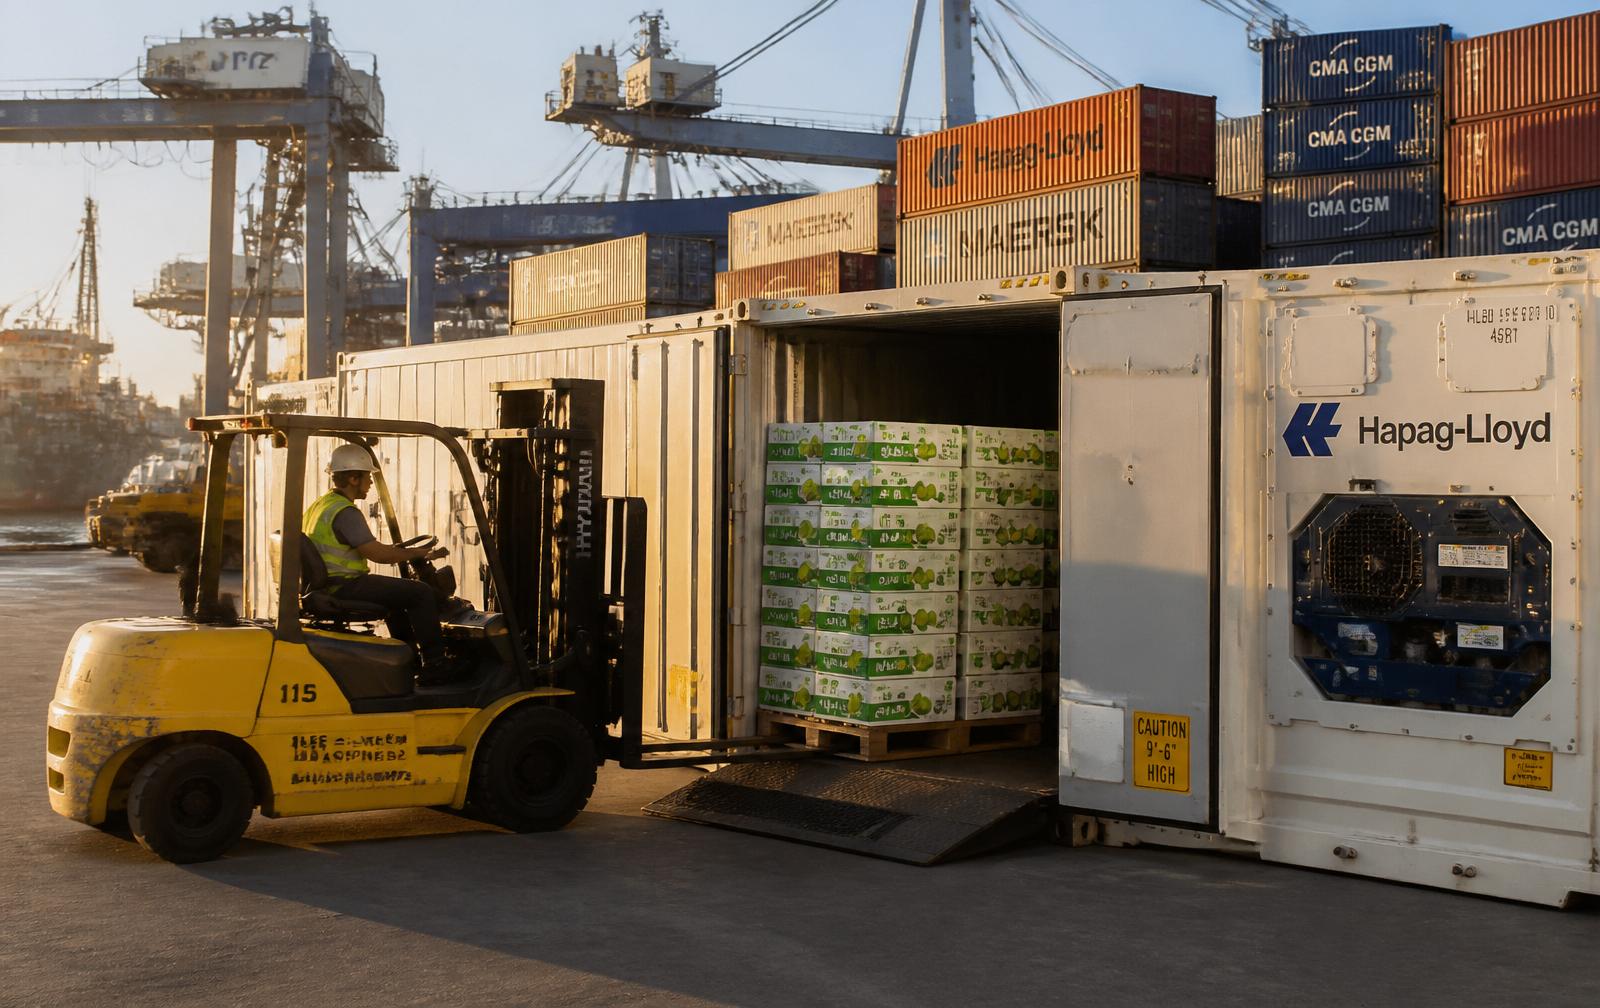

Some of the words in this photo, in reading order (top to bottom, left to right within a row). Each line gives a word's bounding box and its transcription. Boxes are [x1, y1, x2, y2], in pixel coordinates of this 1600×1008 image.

[1309, 58, 1349, 77] CMA
[1354, 54, 1393, 73] CGM
[1308, 127, 1347, 148] CMA
[1351, 124, 1391, 143] CGM
[1307, 199, 1346, 218] CMA
[1350, 195, 1389, 213] CGM
[960, 206, 1104, 258] MAERSK
[1502, 224, 1548, 246] CMA
[1553, 217, 1598, 240] CGM
[1359, 412, 1551, 452] Hapag-Lloyd
[280, 684, 317, 703] 115
[1137, 717, 1187, 738] CAUTION
[1146, 740, 1177, 761] 9'-6"
[1147, 764, 1175, 785] HIGH
